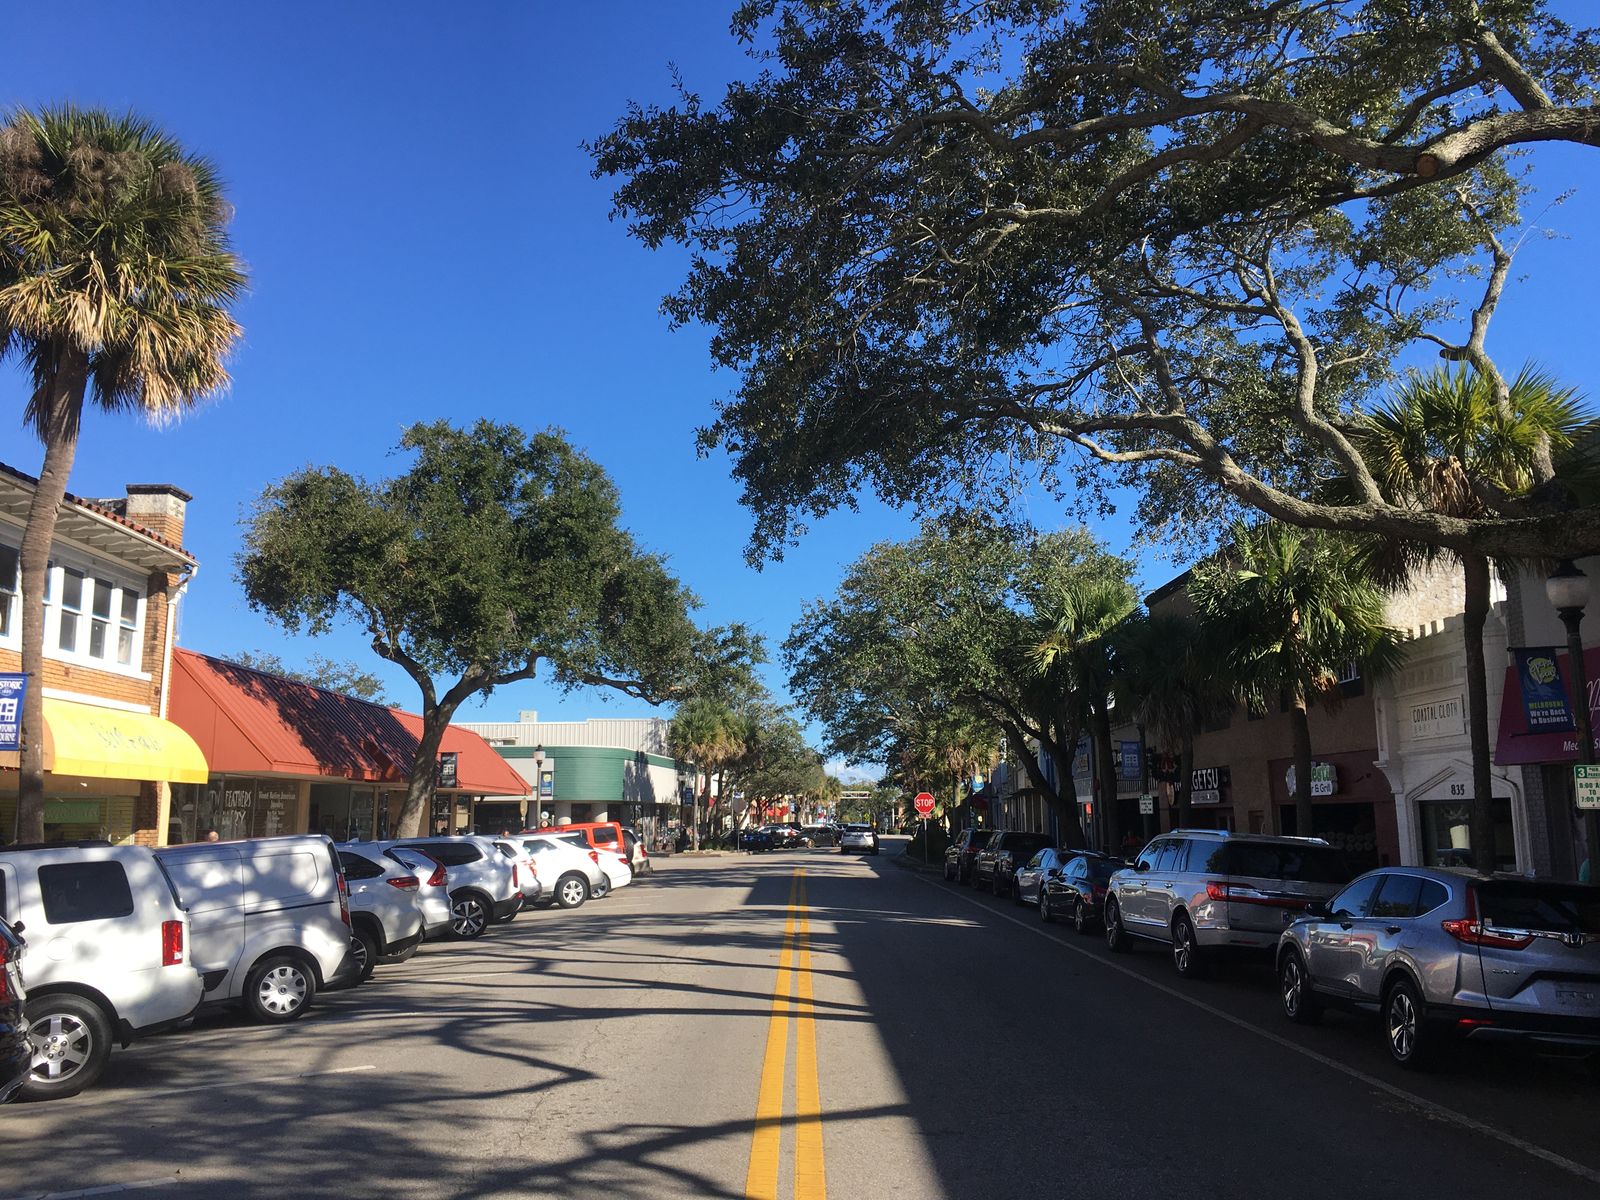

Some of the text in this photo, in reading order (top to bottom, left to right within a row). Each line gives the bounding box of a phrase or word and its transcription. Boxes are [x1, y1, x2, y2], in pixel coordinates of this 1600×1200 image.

[1412, 702, 1458, 723] COASTAL CLOTH
[1577, 767, 1586, 778] 3
[1450, 784, 1465, 796] 835
[916, 799, 934, 807] STOP
